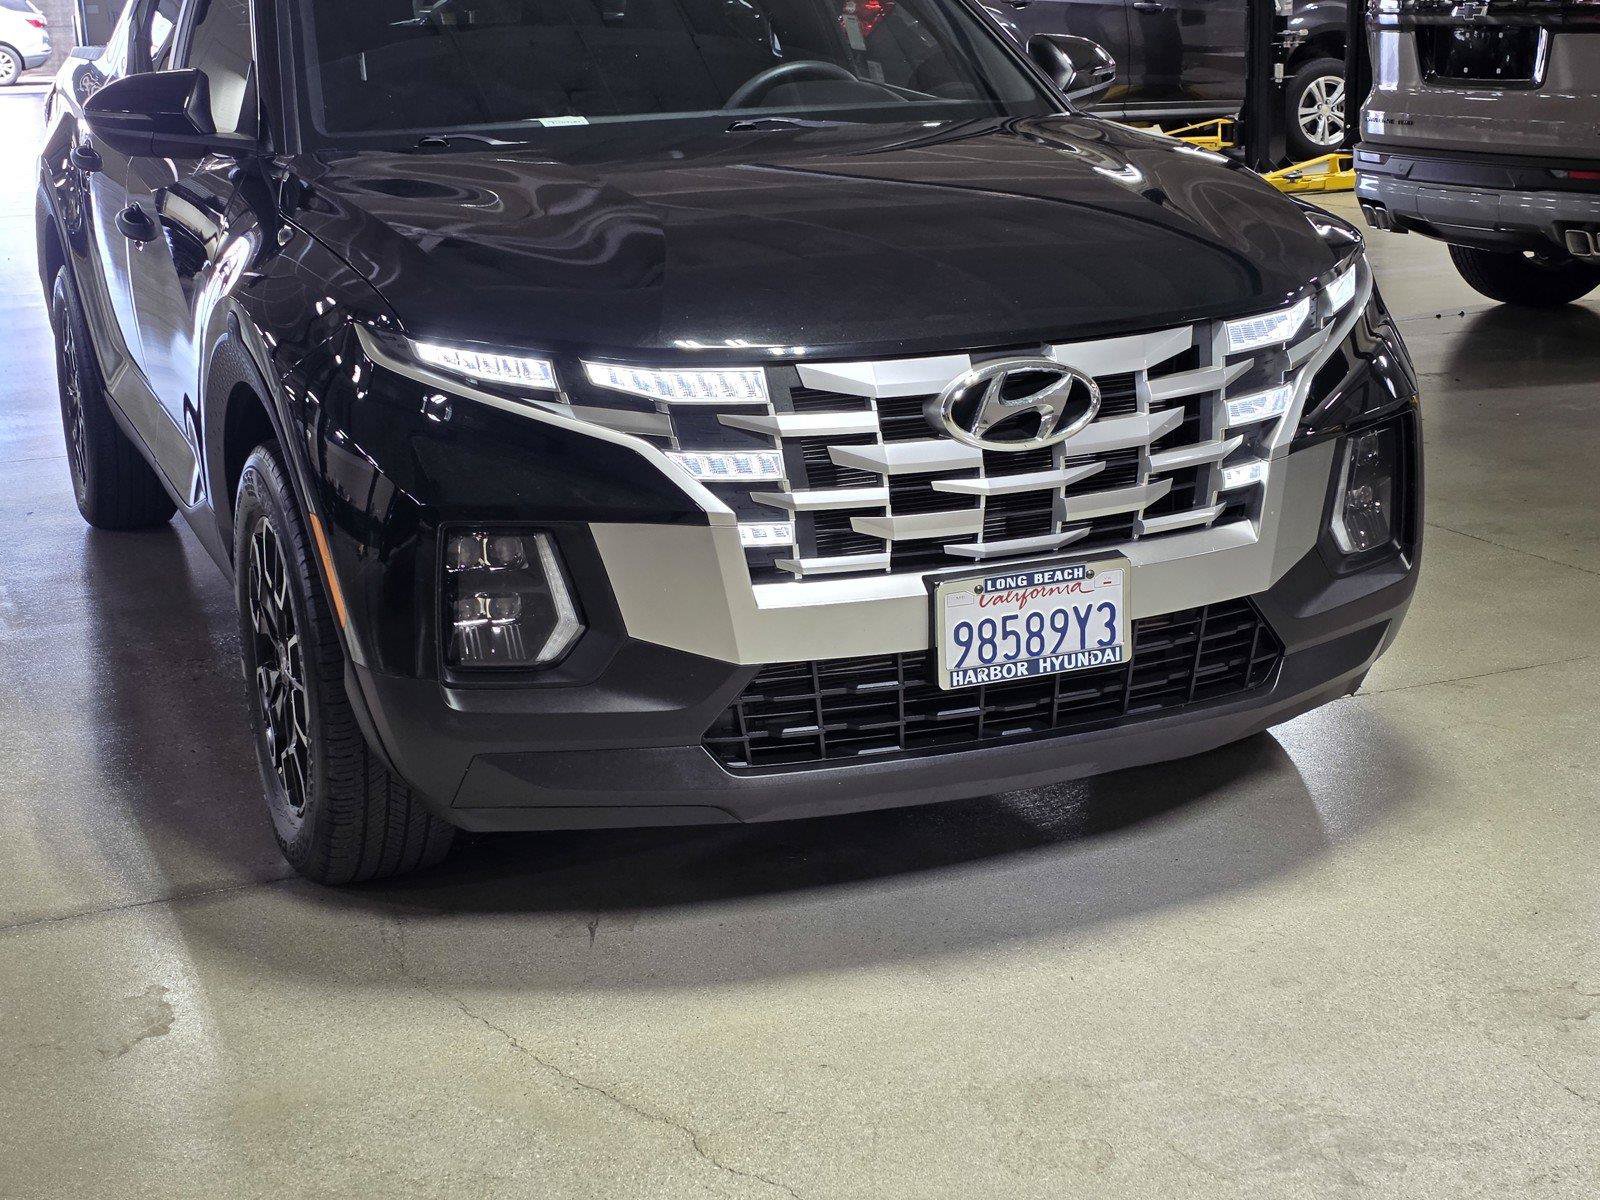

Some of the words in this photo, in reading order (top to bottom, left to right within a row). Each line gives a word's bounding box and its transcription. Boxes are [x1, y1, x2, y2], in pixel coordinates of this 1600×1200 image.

[979, 581, 1094, 610] California
[987, 575, 1027, 591] LONG
[1034, 567, 1083, 585] BEACH
[953, 602, 1116, 669] 98589Y3
[952, 662, 1028, 687] HARBOR
[1039, 647, 1121, 673] HYUNDAI
